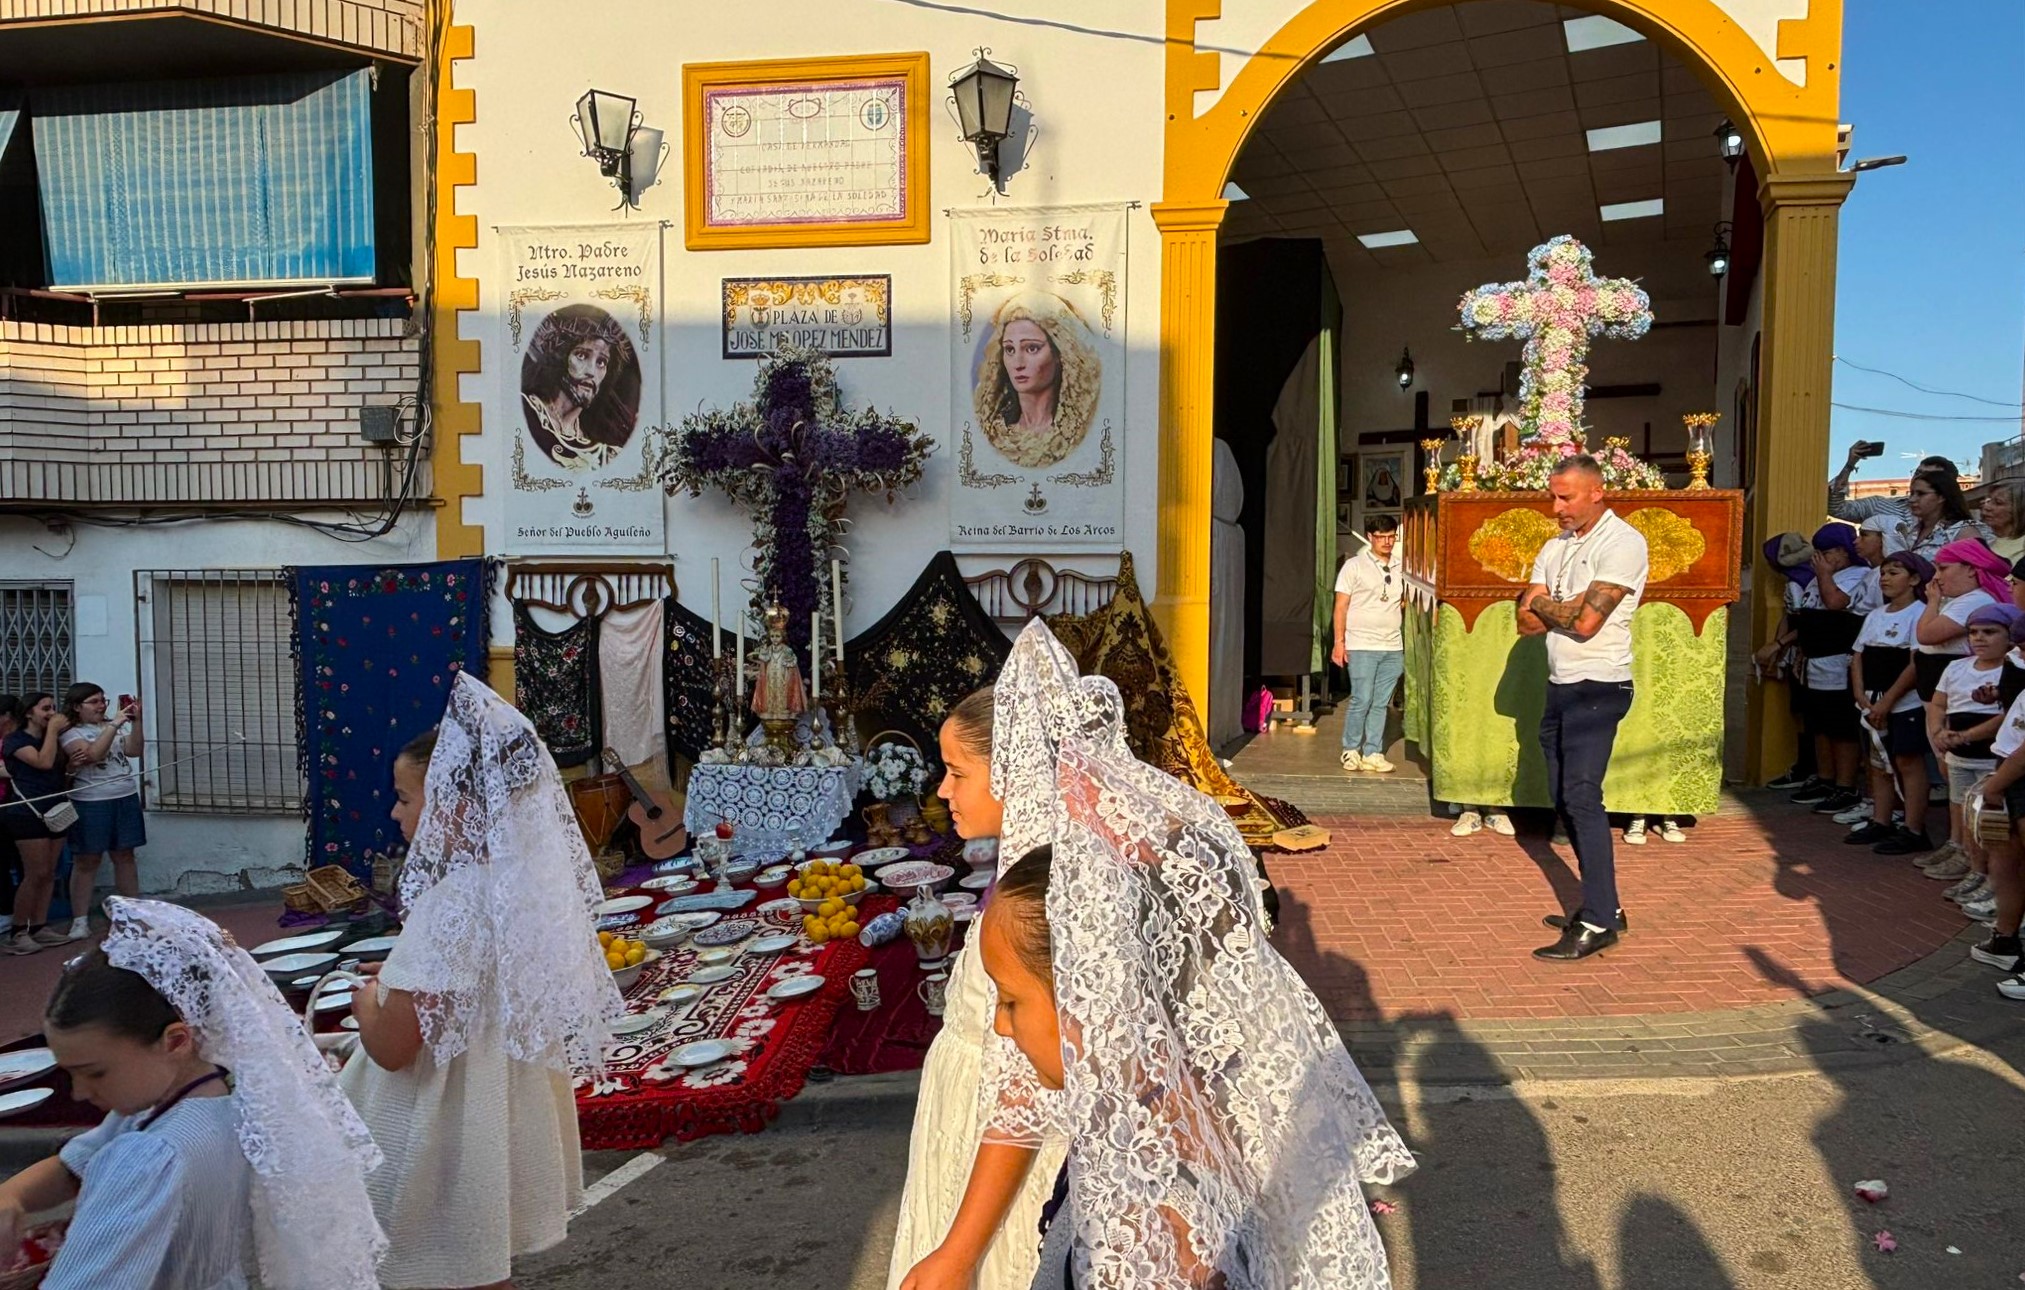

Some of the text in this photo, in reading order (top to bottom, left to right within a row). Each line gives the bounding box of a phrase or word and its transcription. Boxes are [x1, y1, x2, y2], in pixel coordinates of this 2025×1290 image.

[578, 241, 629, 261] Padre
[516, 263, 642, 281] Jesús Nazareno
[773, 309, 838, 325] PLAZA DE
[730, 331, 765, 350] JOSE
[830, 328, 883, 349] MENDEZ
[517, 525, 651, 540] Señor del Pueblo Aguileño
[957, 524, 1116, 536] Reina del Barrio de Los Arcos
